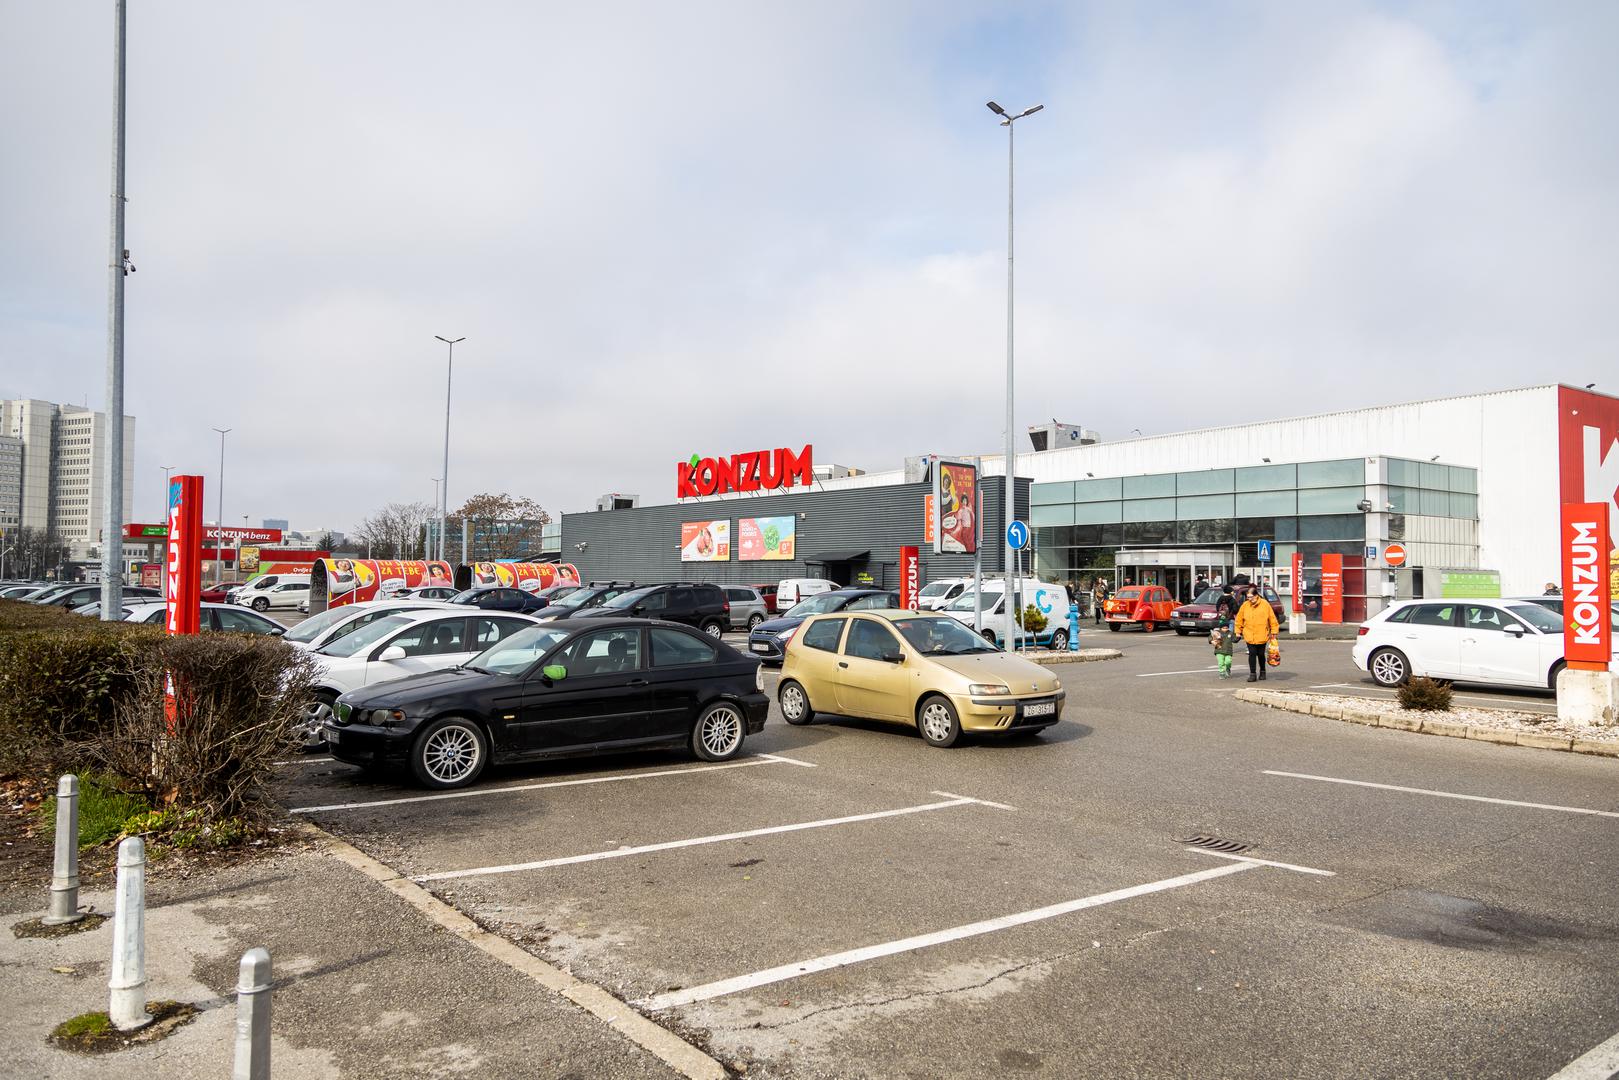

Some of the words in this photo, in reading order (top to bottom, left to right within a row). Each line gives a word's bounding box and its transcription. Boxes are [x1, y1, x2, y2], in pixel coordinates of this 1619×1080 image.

[678, 444, 812, 498] KONZUM
[207, 530, 249, 539] KONZUM
[250, 532, 271, 541] benz
[381, 567, 393, 575] ZA
[395, 567, 420, 575] TEBE
[519, 569, 529, 577] ZA
[908, 557, 917, 611] ONZUM
[1570, 521, 1601, 645] KONZUM
